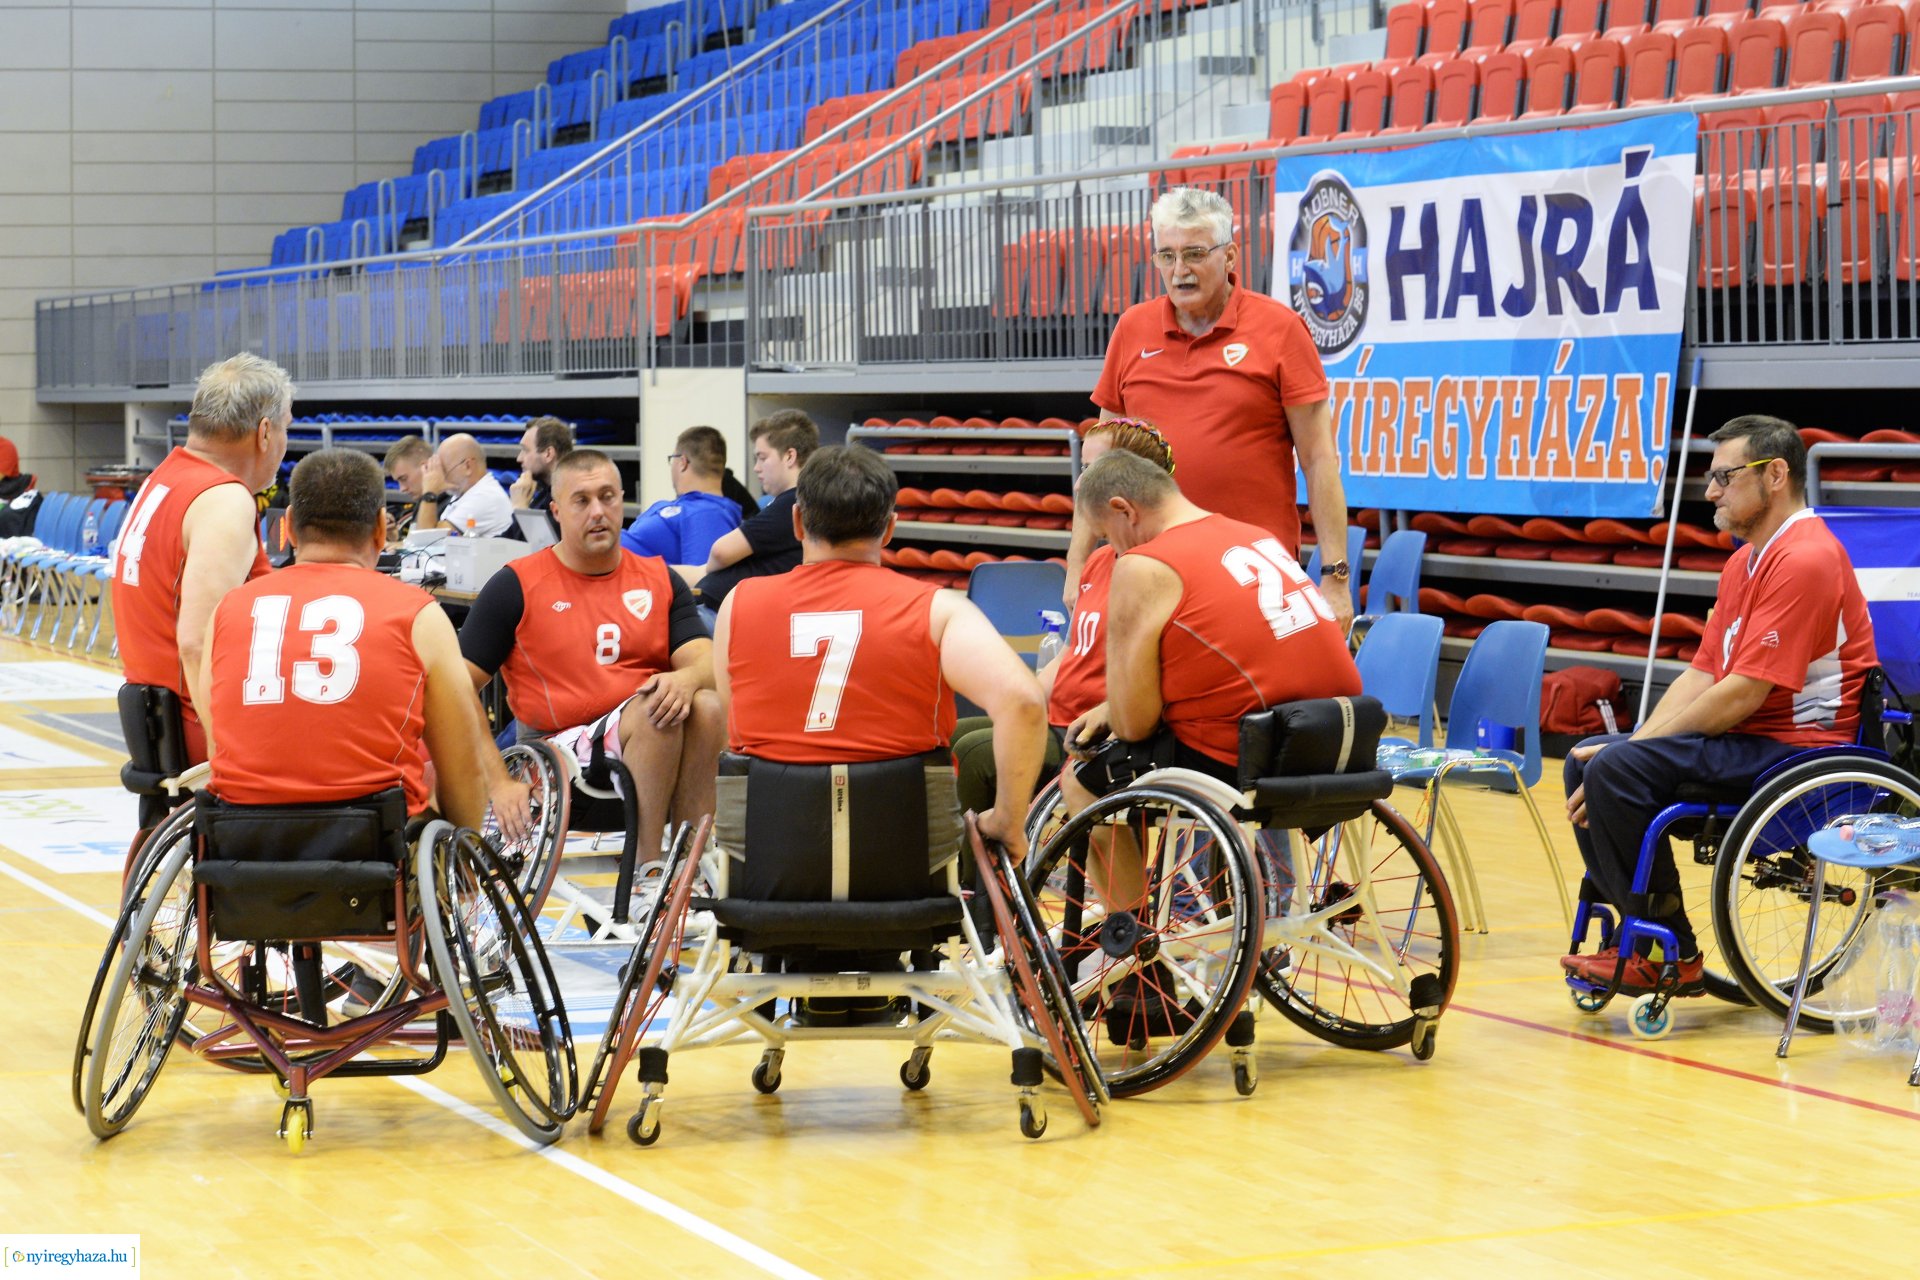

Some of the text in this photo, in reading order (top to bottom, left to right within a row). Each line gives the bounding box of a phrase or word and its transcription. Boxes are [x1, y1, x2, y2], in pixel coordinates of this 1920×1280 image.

[1385, 144, 1661, 321] HAJRÁ
[1294, 341, 1672, 483] YÍREGYHÁZA!
[595, 623, 621, 666] 8
[1073, 610, 1101, 657] 10
[1221, 538, 1337, 641] 25
[243, 594, 365, 706] 13
[790, 610, 863, 733] 7
